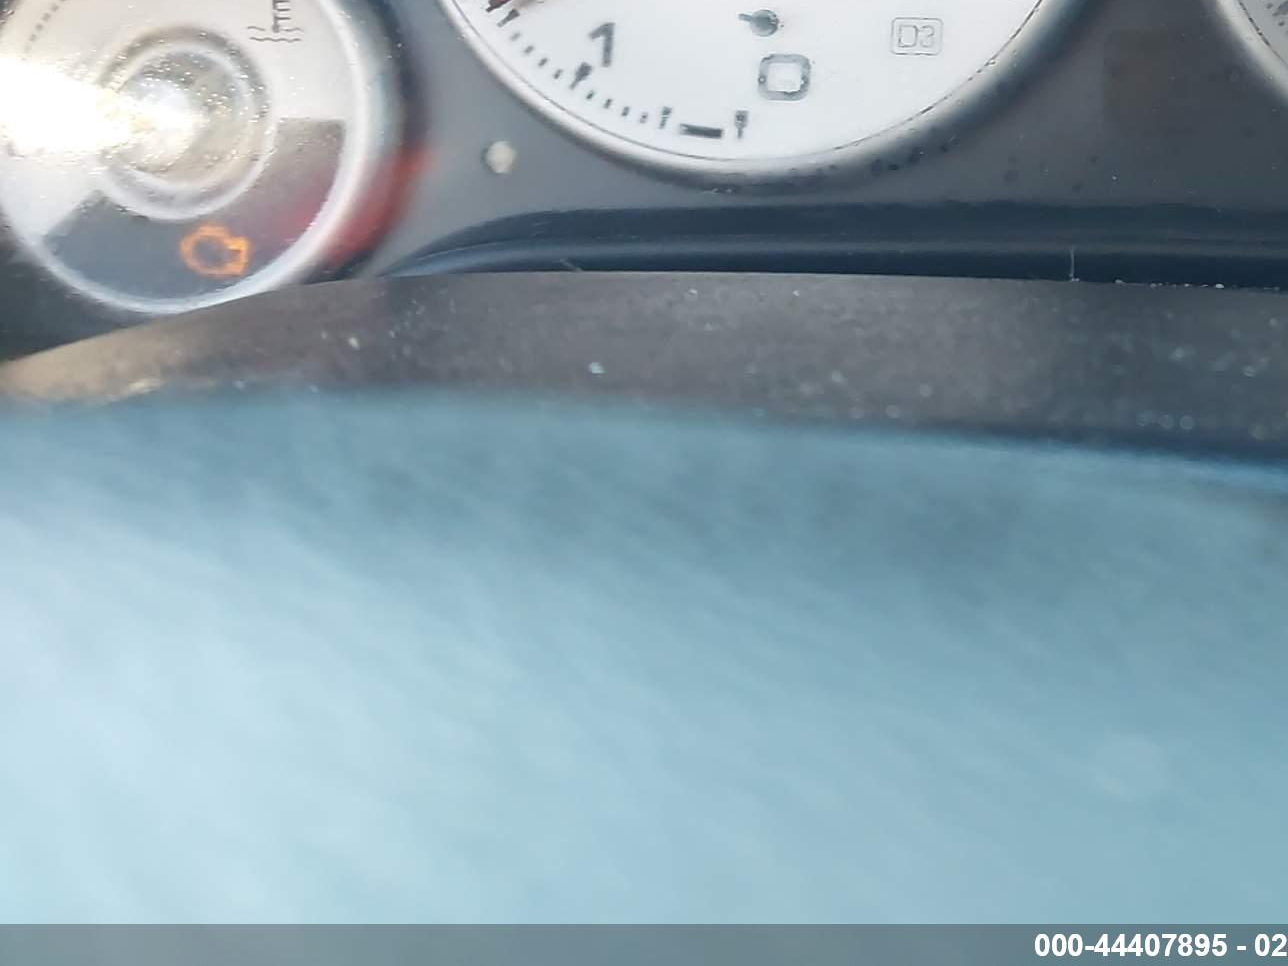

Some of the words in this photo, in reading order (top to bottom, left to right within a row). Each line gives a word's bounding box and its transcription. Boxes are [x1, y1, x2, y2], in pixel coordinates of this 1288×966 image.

[588, 22, 616, 67] 1
[898, 25, 936, 48] D3
[758, 53, 812, 101] 0
